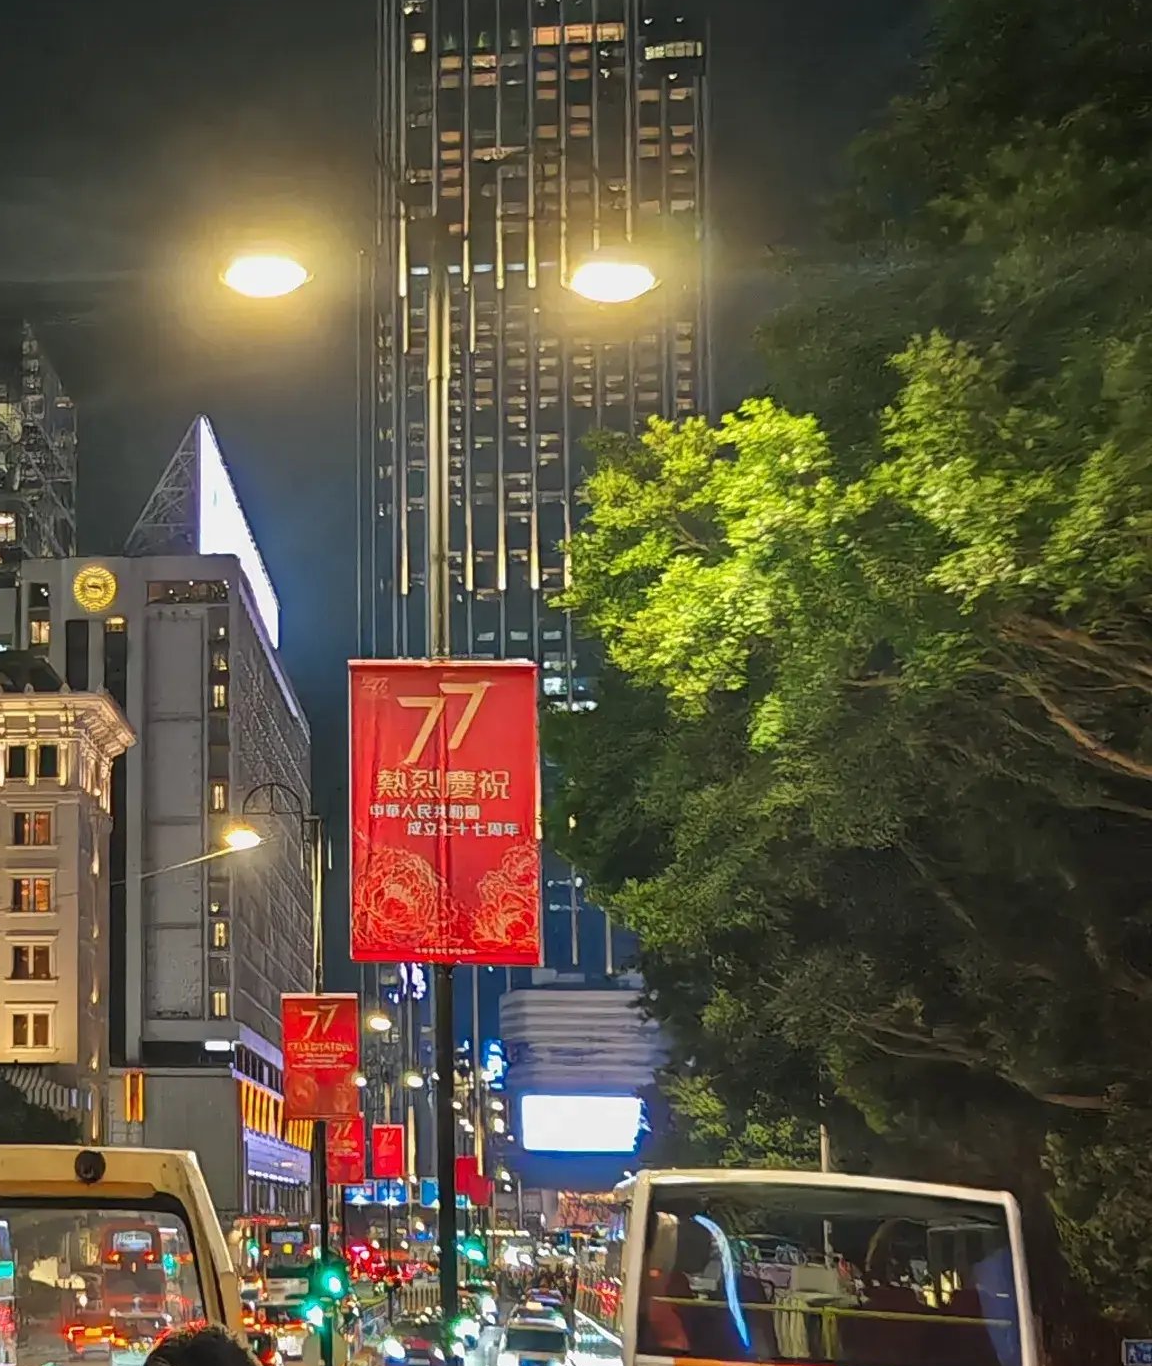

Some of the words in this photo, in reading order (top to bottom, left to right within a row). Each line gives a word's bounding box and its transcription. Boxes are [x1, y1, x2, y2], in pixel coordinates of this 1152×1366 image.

[397, 681, 495, 766] 77
[376, 768, 511, 800] 熱烈慶祝
[301, 1004, 340, 1042] 77
